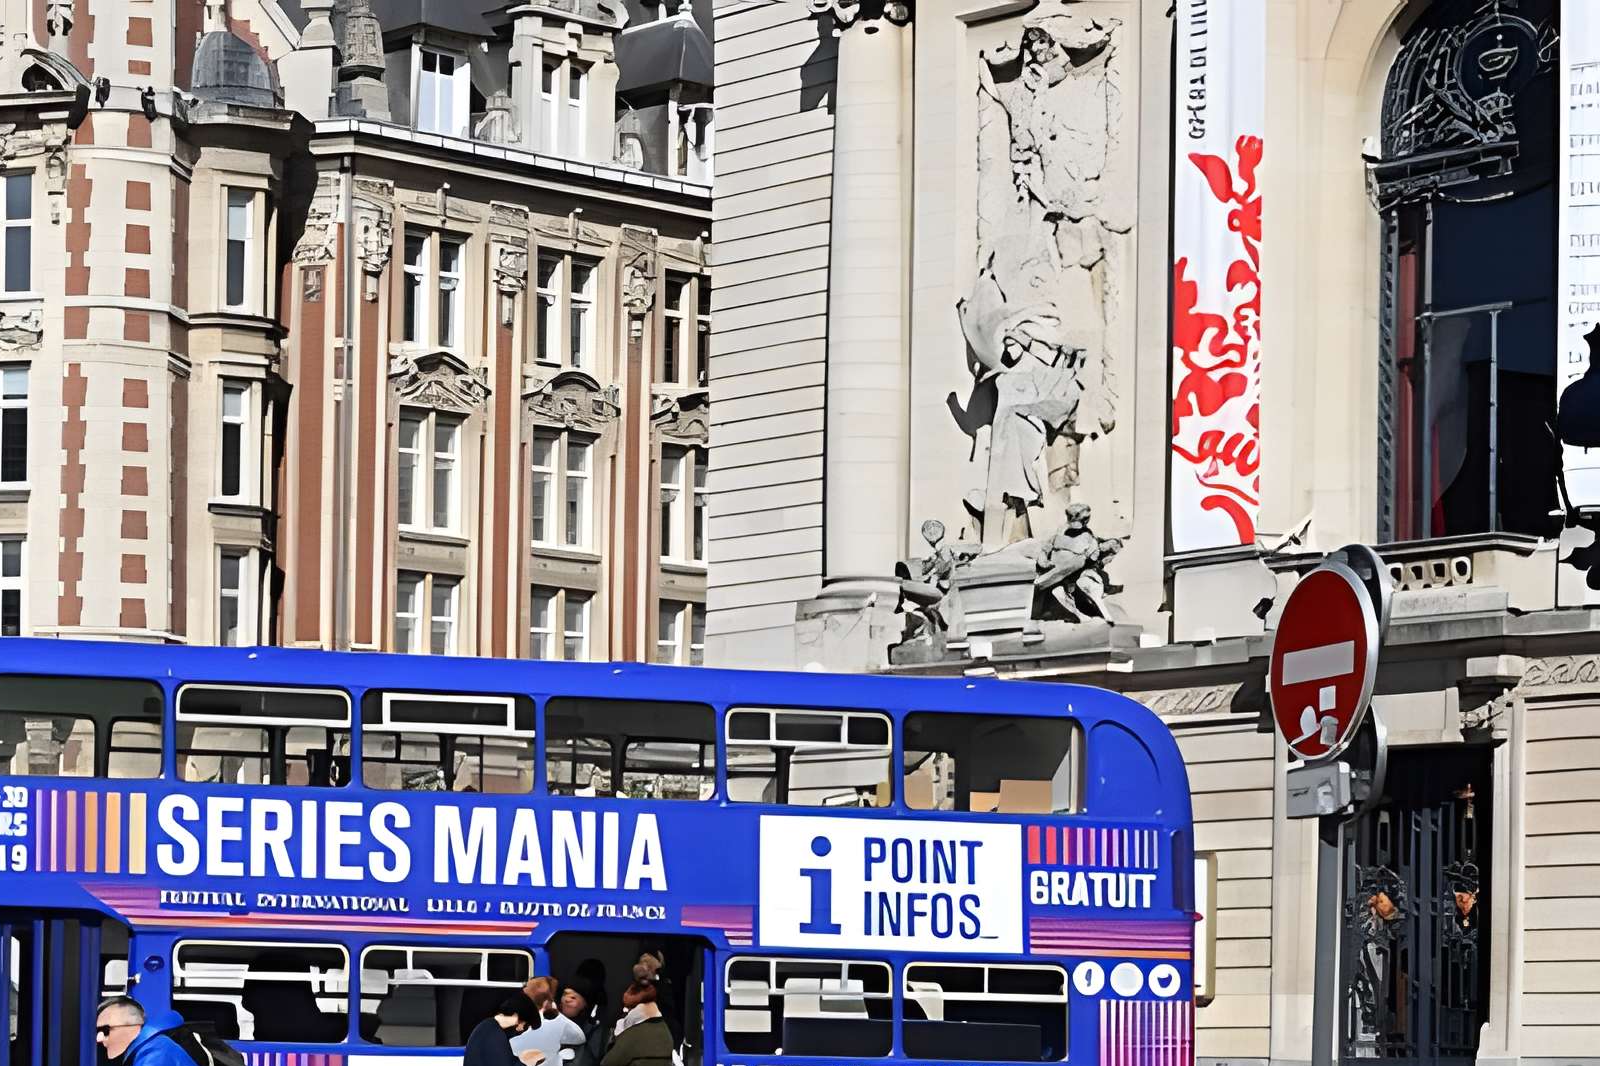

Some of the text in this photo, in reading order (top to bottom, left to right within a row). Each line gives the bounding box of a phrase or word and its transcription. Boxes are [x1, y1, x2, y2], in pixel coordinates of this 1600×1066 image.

[157, 794, 668, 890] SERIES MANIA
[864, 836, 984, 885] POINT
[1030, 870, 1157, 908] GRATUIT
[864, 890, 981, 939] INFOS
